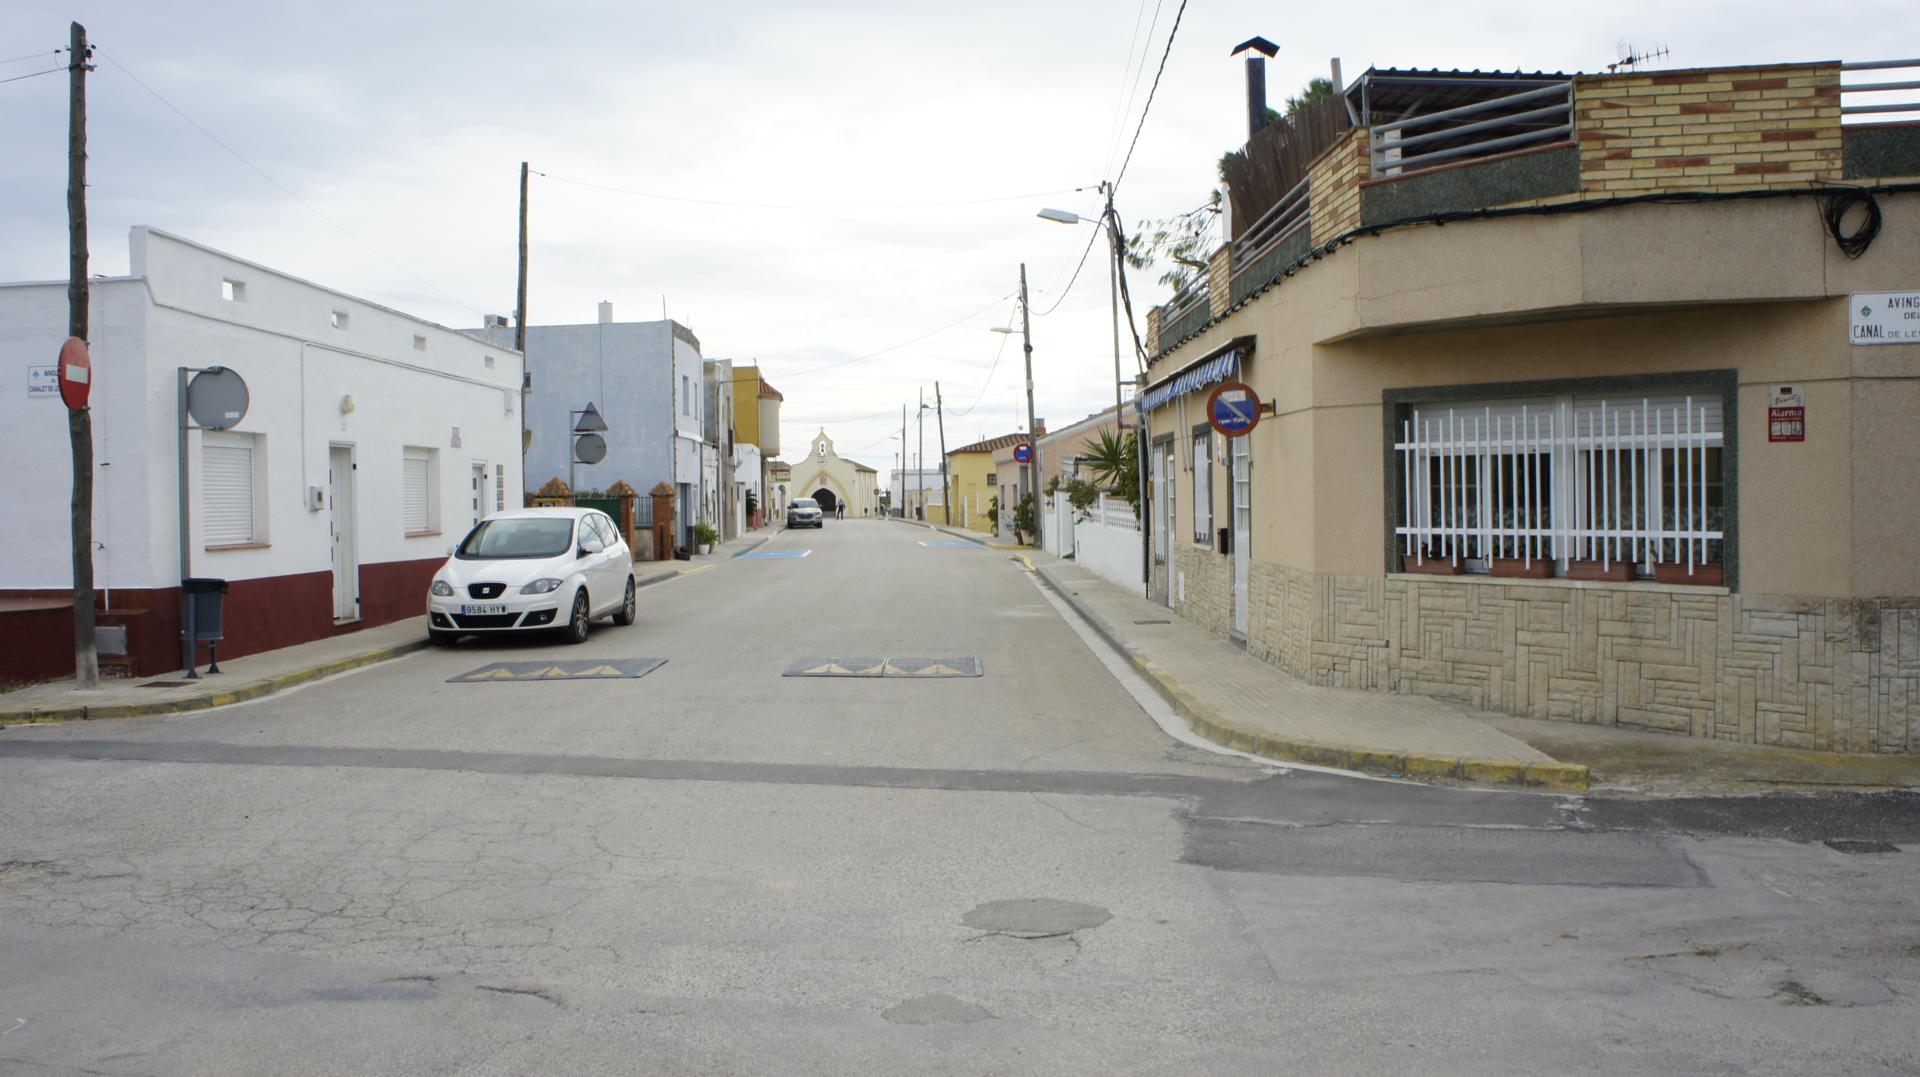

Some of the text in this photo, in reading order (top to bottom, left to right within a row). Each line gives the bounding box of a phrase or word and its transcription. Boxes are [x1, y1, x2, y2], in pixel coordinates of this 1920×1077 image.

[1888, 296, 1920, 309] AVING
[1853, 324, 1920, 339] CANAL DE LE
[1771, 409, 1802, 417] Alarma
[467, 605, 487, 614] 9584
